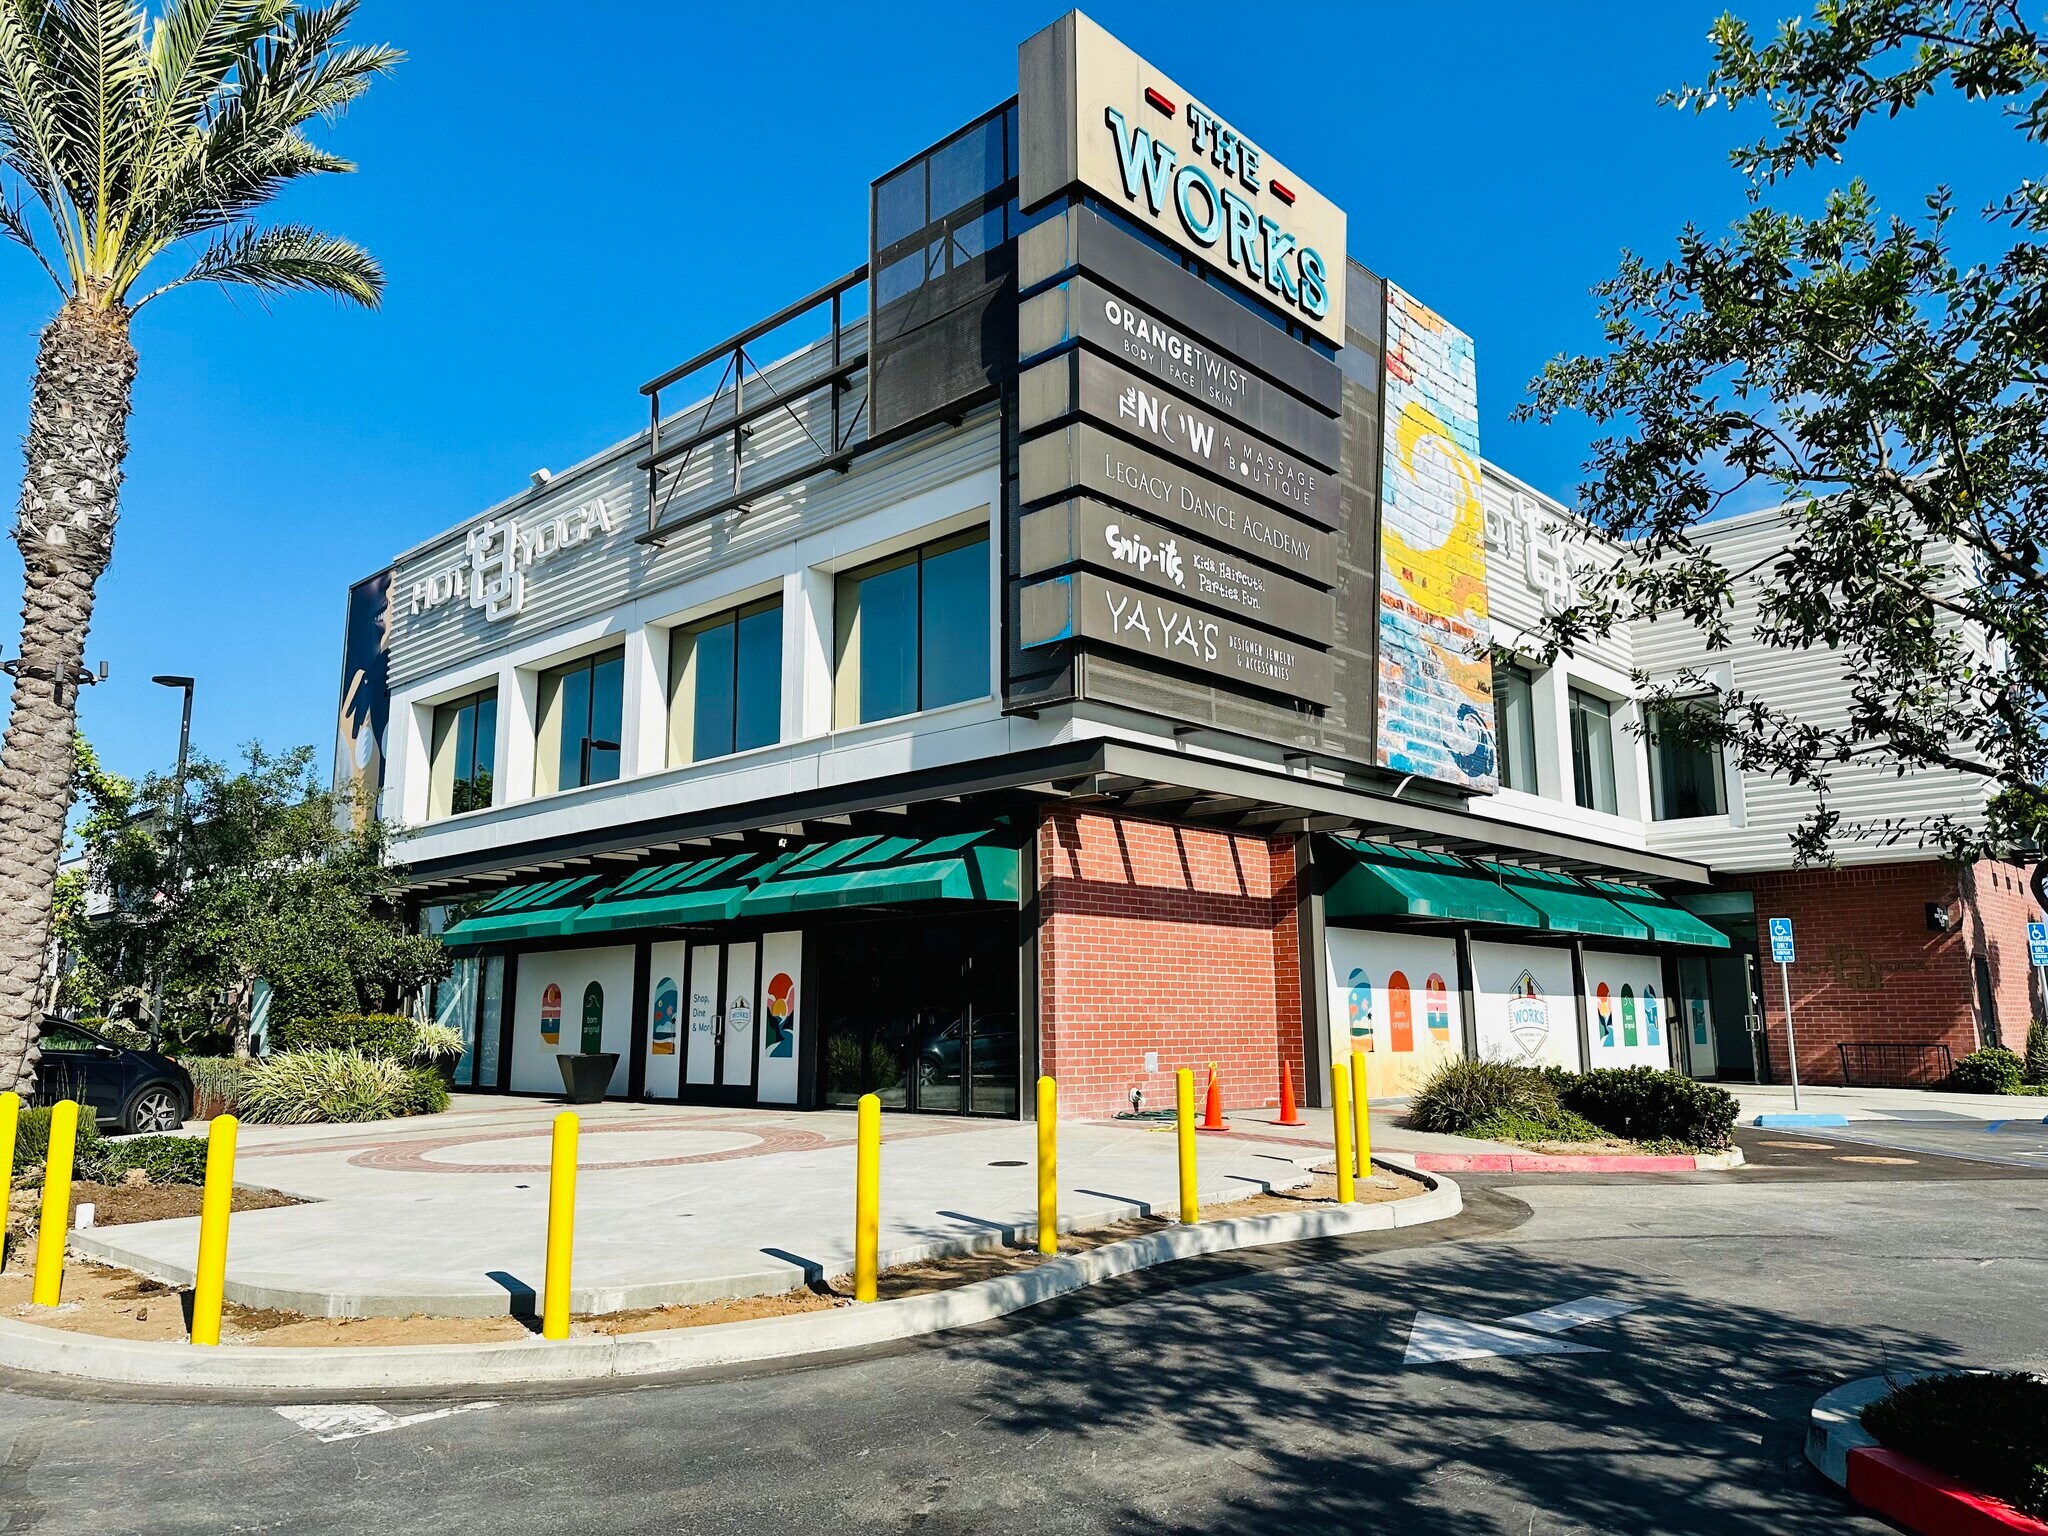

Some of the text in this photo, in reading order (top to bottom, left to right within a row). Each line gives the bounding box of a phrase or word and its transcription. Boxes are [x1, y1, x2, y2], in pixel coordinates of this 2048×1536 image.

[1187, 103, 1260, 196] THE
[1105, 106, 1329, 321] WORKS
[1105, 300, 1247, 396] ORANGETWIST
[1124, 339, 1232, 408] BODY FACE SKIN
[1138, 390, 1214, 459] NOW
[1223, 435, 1315, 491] A MASSAGE
[1229, 456, 1310, 506] BOUTIQUE
[1105, 454, 1311, 561] LEGACY DANCE ACADEMY
[411, 497, 611, 615] HOT YOGA
[1193, 554, 1265, 593] Kids. Haircuts.
[1199, 573, 1261, 609] Parties. Fun.
[1106, 590, 1219, 662] YA YA'S
[1229, 635, 1295, 667] DESIGNER JEWELRY
[1237, 654, 1289, 681] & ACCESSORIES
[587, 1016, 598, 1024] born
[693, 994, 710, 1005] Shop,
[693, 1008, 706, 1018] Dine
[731, 1011, 749, 1019] WORKS
[1513, 1008, 1545, 1025] WORKS
[692, 1022, 714, 1032] & Mor
